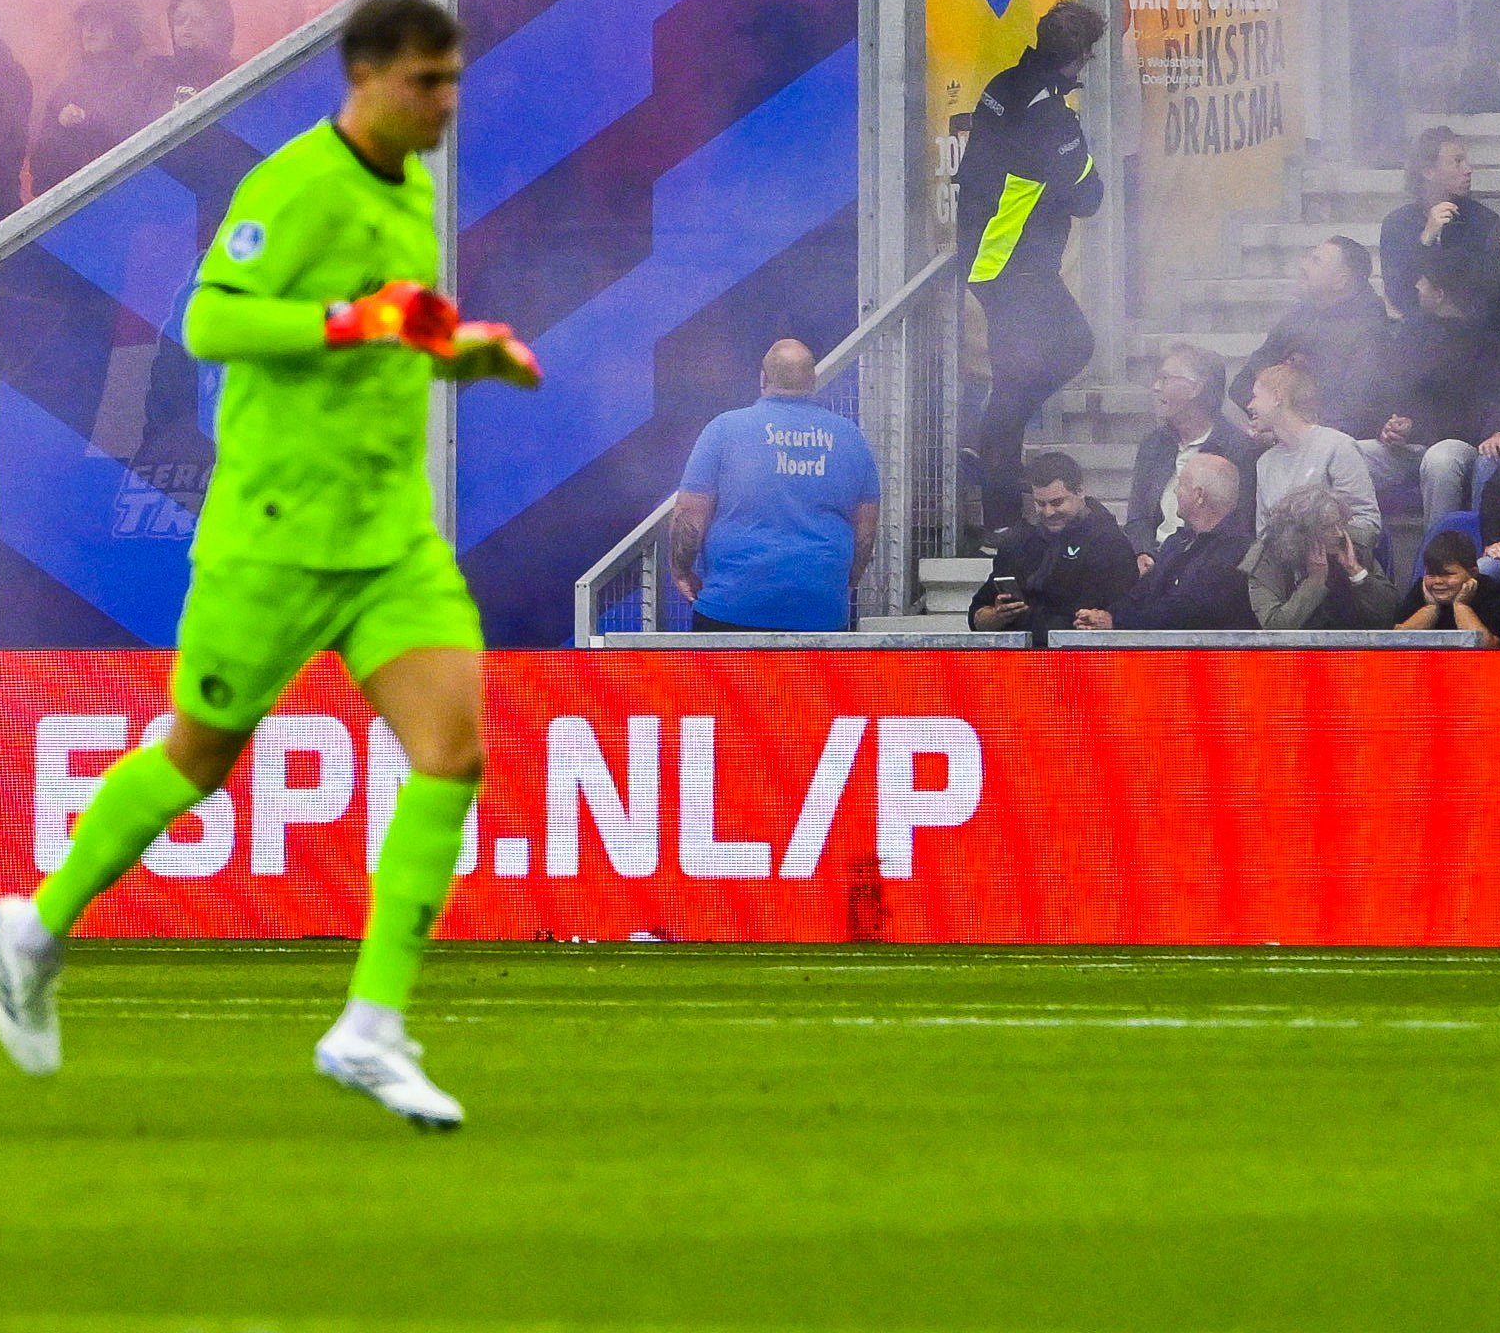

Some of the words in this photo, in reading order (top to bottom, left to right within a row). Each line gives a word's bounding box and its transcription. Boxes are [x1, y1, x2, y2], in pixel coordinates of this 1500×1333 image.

[1164, 83, 1283, 156] DRAISMA
[765, 422, 834, 452] Security
[776, 451, 826, 476] Noord
